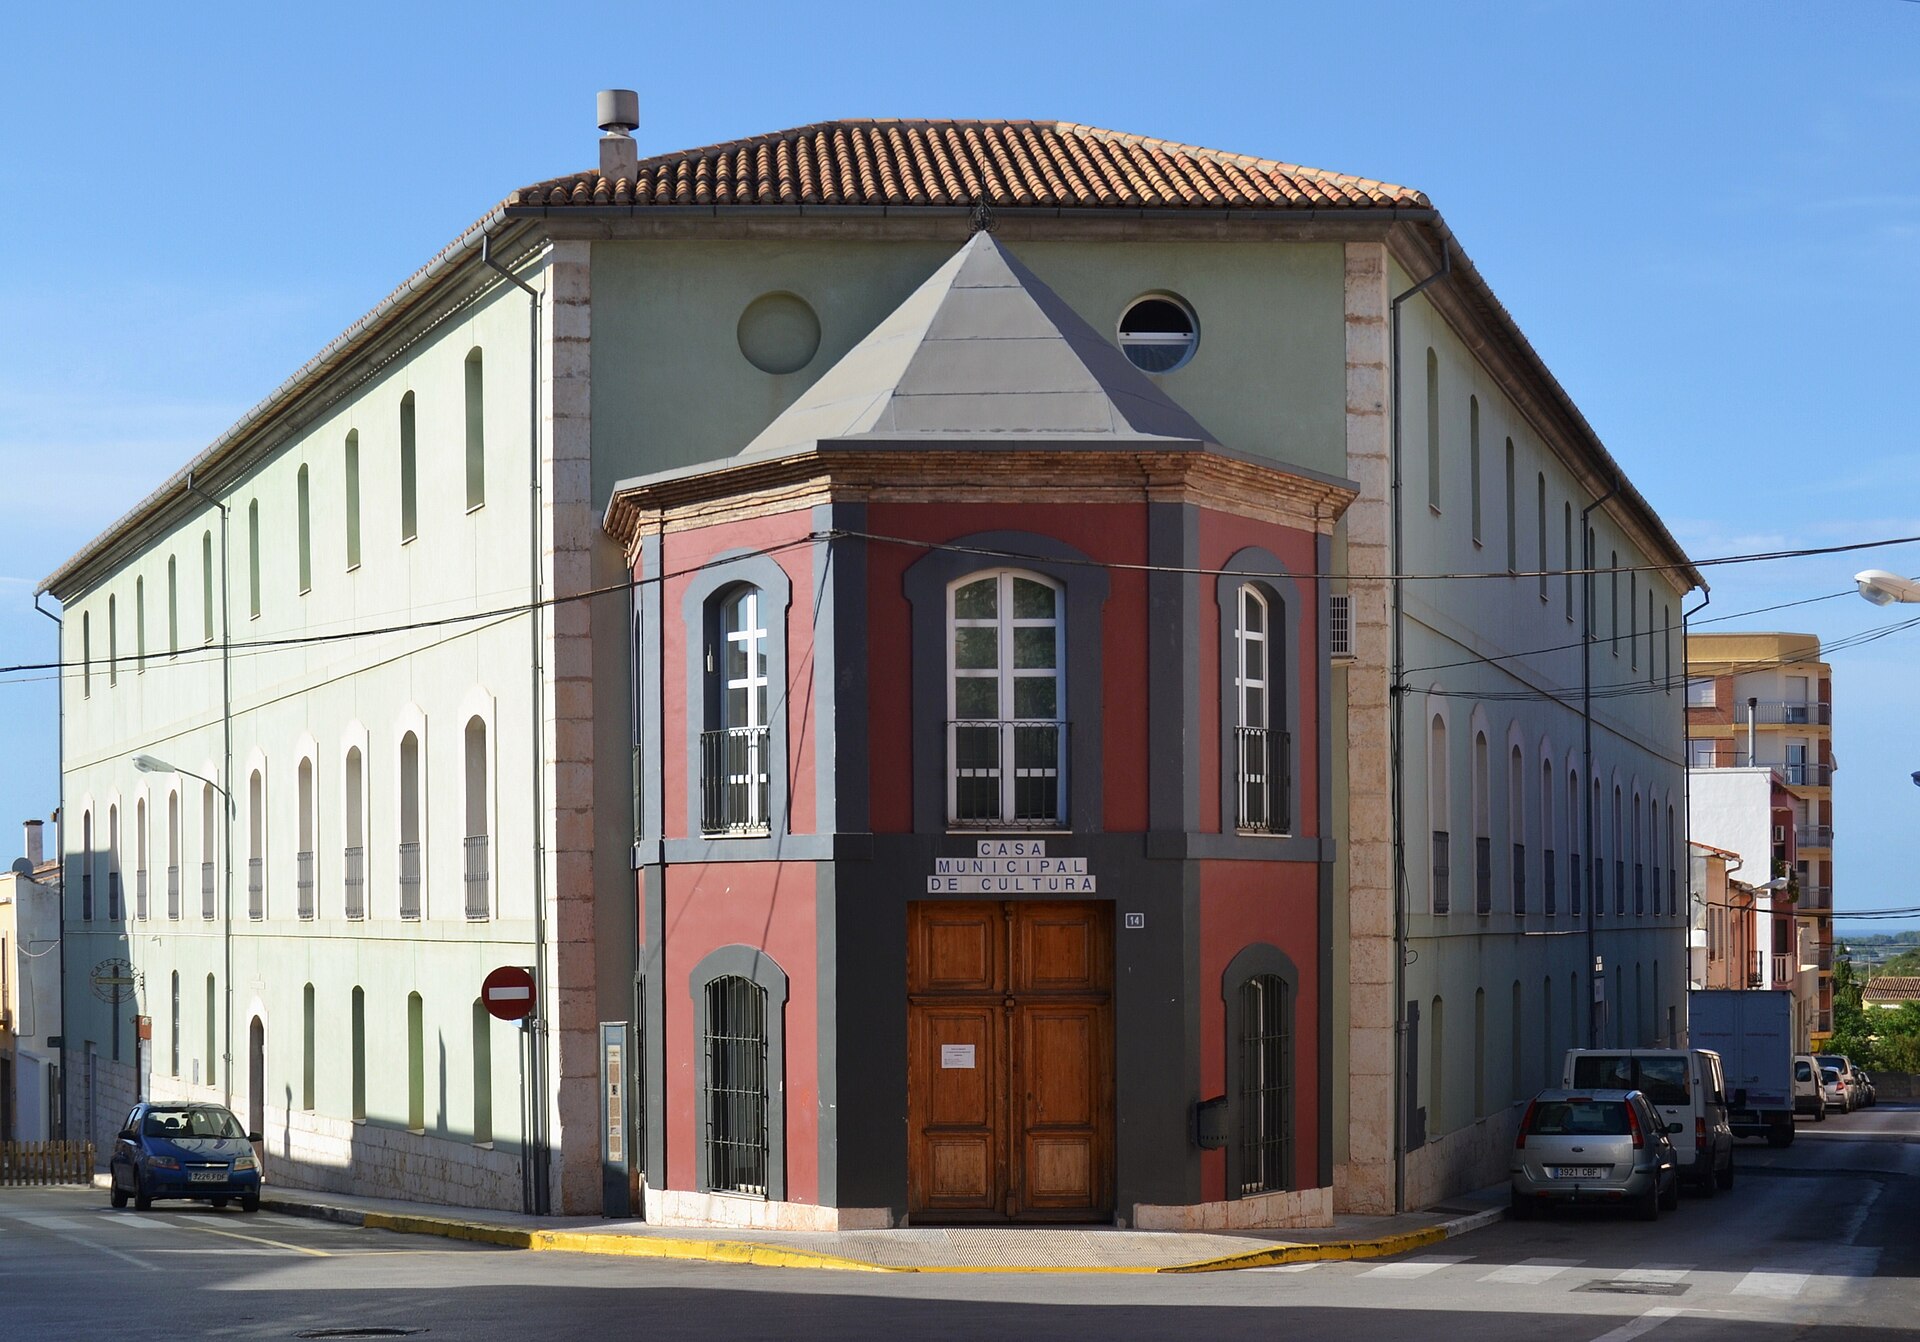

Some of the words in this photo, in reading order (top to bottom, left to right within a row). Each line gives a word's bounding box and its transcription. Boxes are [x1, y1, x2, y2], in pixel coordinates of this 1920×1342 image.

[981, 843, 1041, 855] CASA
[939, 860, 1083, 873] MUNICIPAL
[931, 878, 958, 891] DE
[981, 878, 1092, 891] CULTURA
[1130, 916, 1140, 925] 14
[1559, 1168, 1578, 1176] 3921
[1582, 1168, 1598, 1176] CBF
